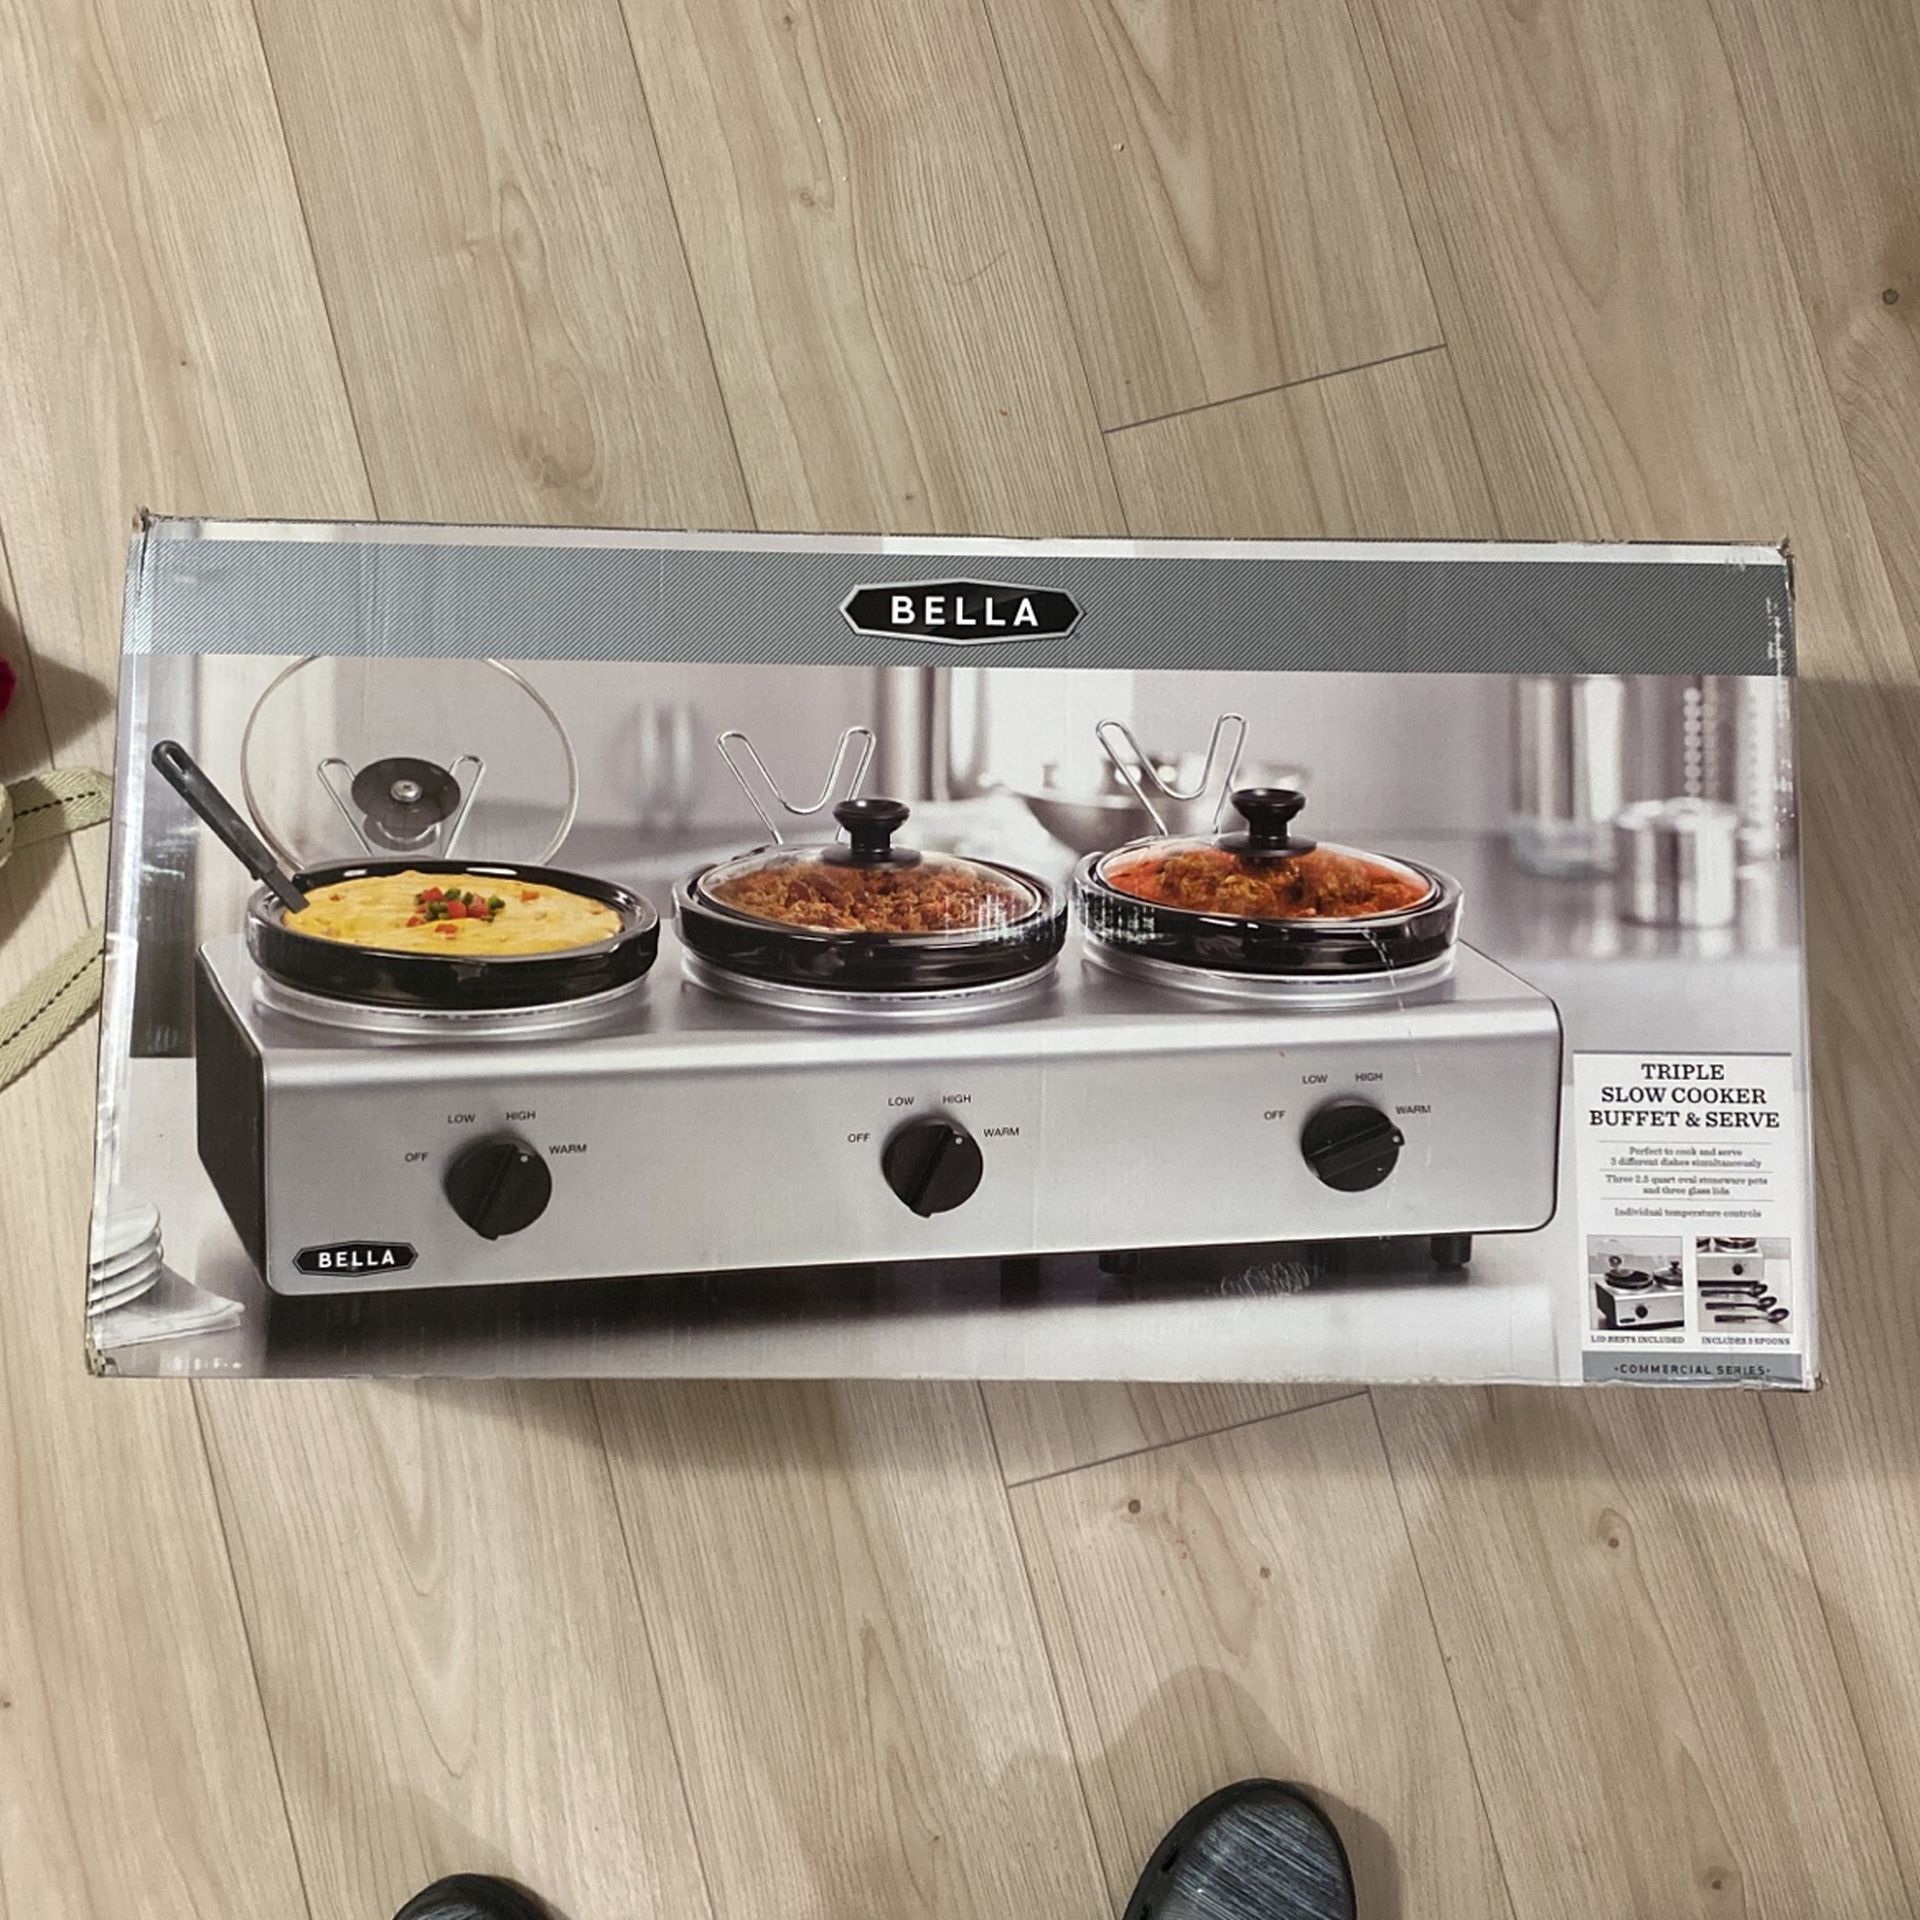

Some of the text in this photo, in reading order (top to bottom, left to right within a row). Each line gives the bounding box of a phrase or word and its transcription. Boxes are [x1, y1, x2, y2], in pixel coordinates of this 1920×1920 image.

[891, 596, 1039, 627] BELLA
[1641, 1064, 1724, 1080] TRIPLE
[1302, 1075, 1328, 1084] LOW
[1355, 1073, 1383, 1082] HIGH
[942, 1095, 971, 1104] HIGH
[1602, 1087, 1767, 1104] SLOW COOKER
[888, 1097, 914, 1106] LOW
[1396, 1105, 1431, 1115] WARM
[448, 1114, 475, 1124] LOW
[506, 1111, 536, 1121] HIGH
[1264, 1111, 1286, 1120] OFF
[1590, 1111, 1780, 1128] BUFFET & SERVE
[984, 1127, 1019, 1137] WARM
[848, 1133, 871, 1143] OFF
[549, 1144, 587, 1154] WARM
[1629, 1147, 1662, 1156] Perfect
[1665, 1148, 1673, 1156] to
[1676, 1148, 1696, 1156] cook
[1700, 1148, 1716, 1156] and
[405, 1152, 428, 1162] OFF
[1618, 1157, 1659, 1166] different
[1660, 1158, 1689, 1166] dishes
[1692, 1159, 1761, 1169] simultaneously
[1606, 1175, 1768, 1187] Three 2.5 quart oval stoneware pots
[1662, 1187, 1686, 1195] three
[1688, 1187, 1710, 1197] glass
[1713, 1187, 1729, 1195] lids
[1614, 1208, 1761, 1218] Individual temperature controls
[318, 1250, 395, 1268] BELLA
